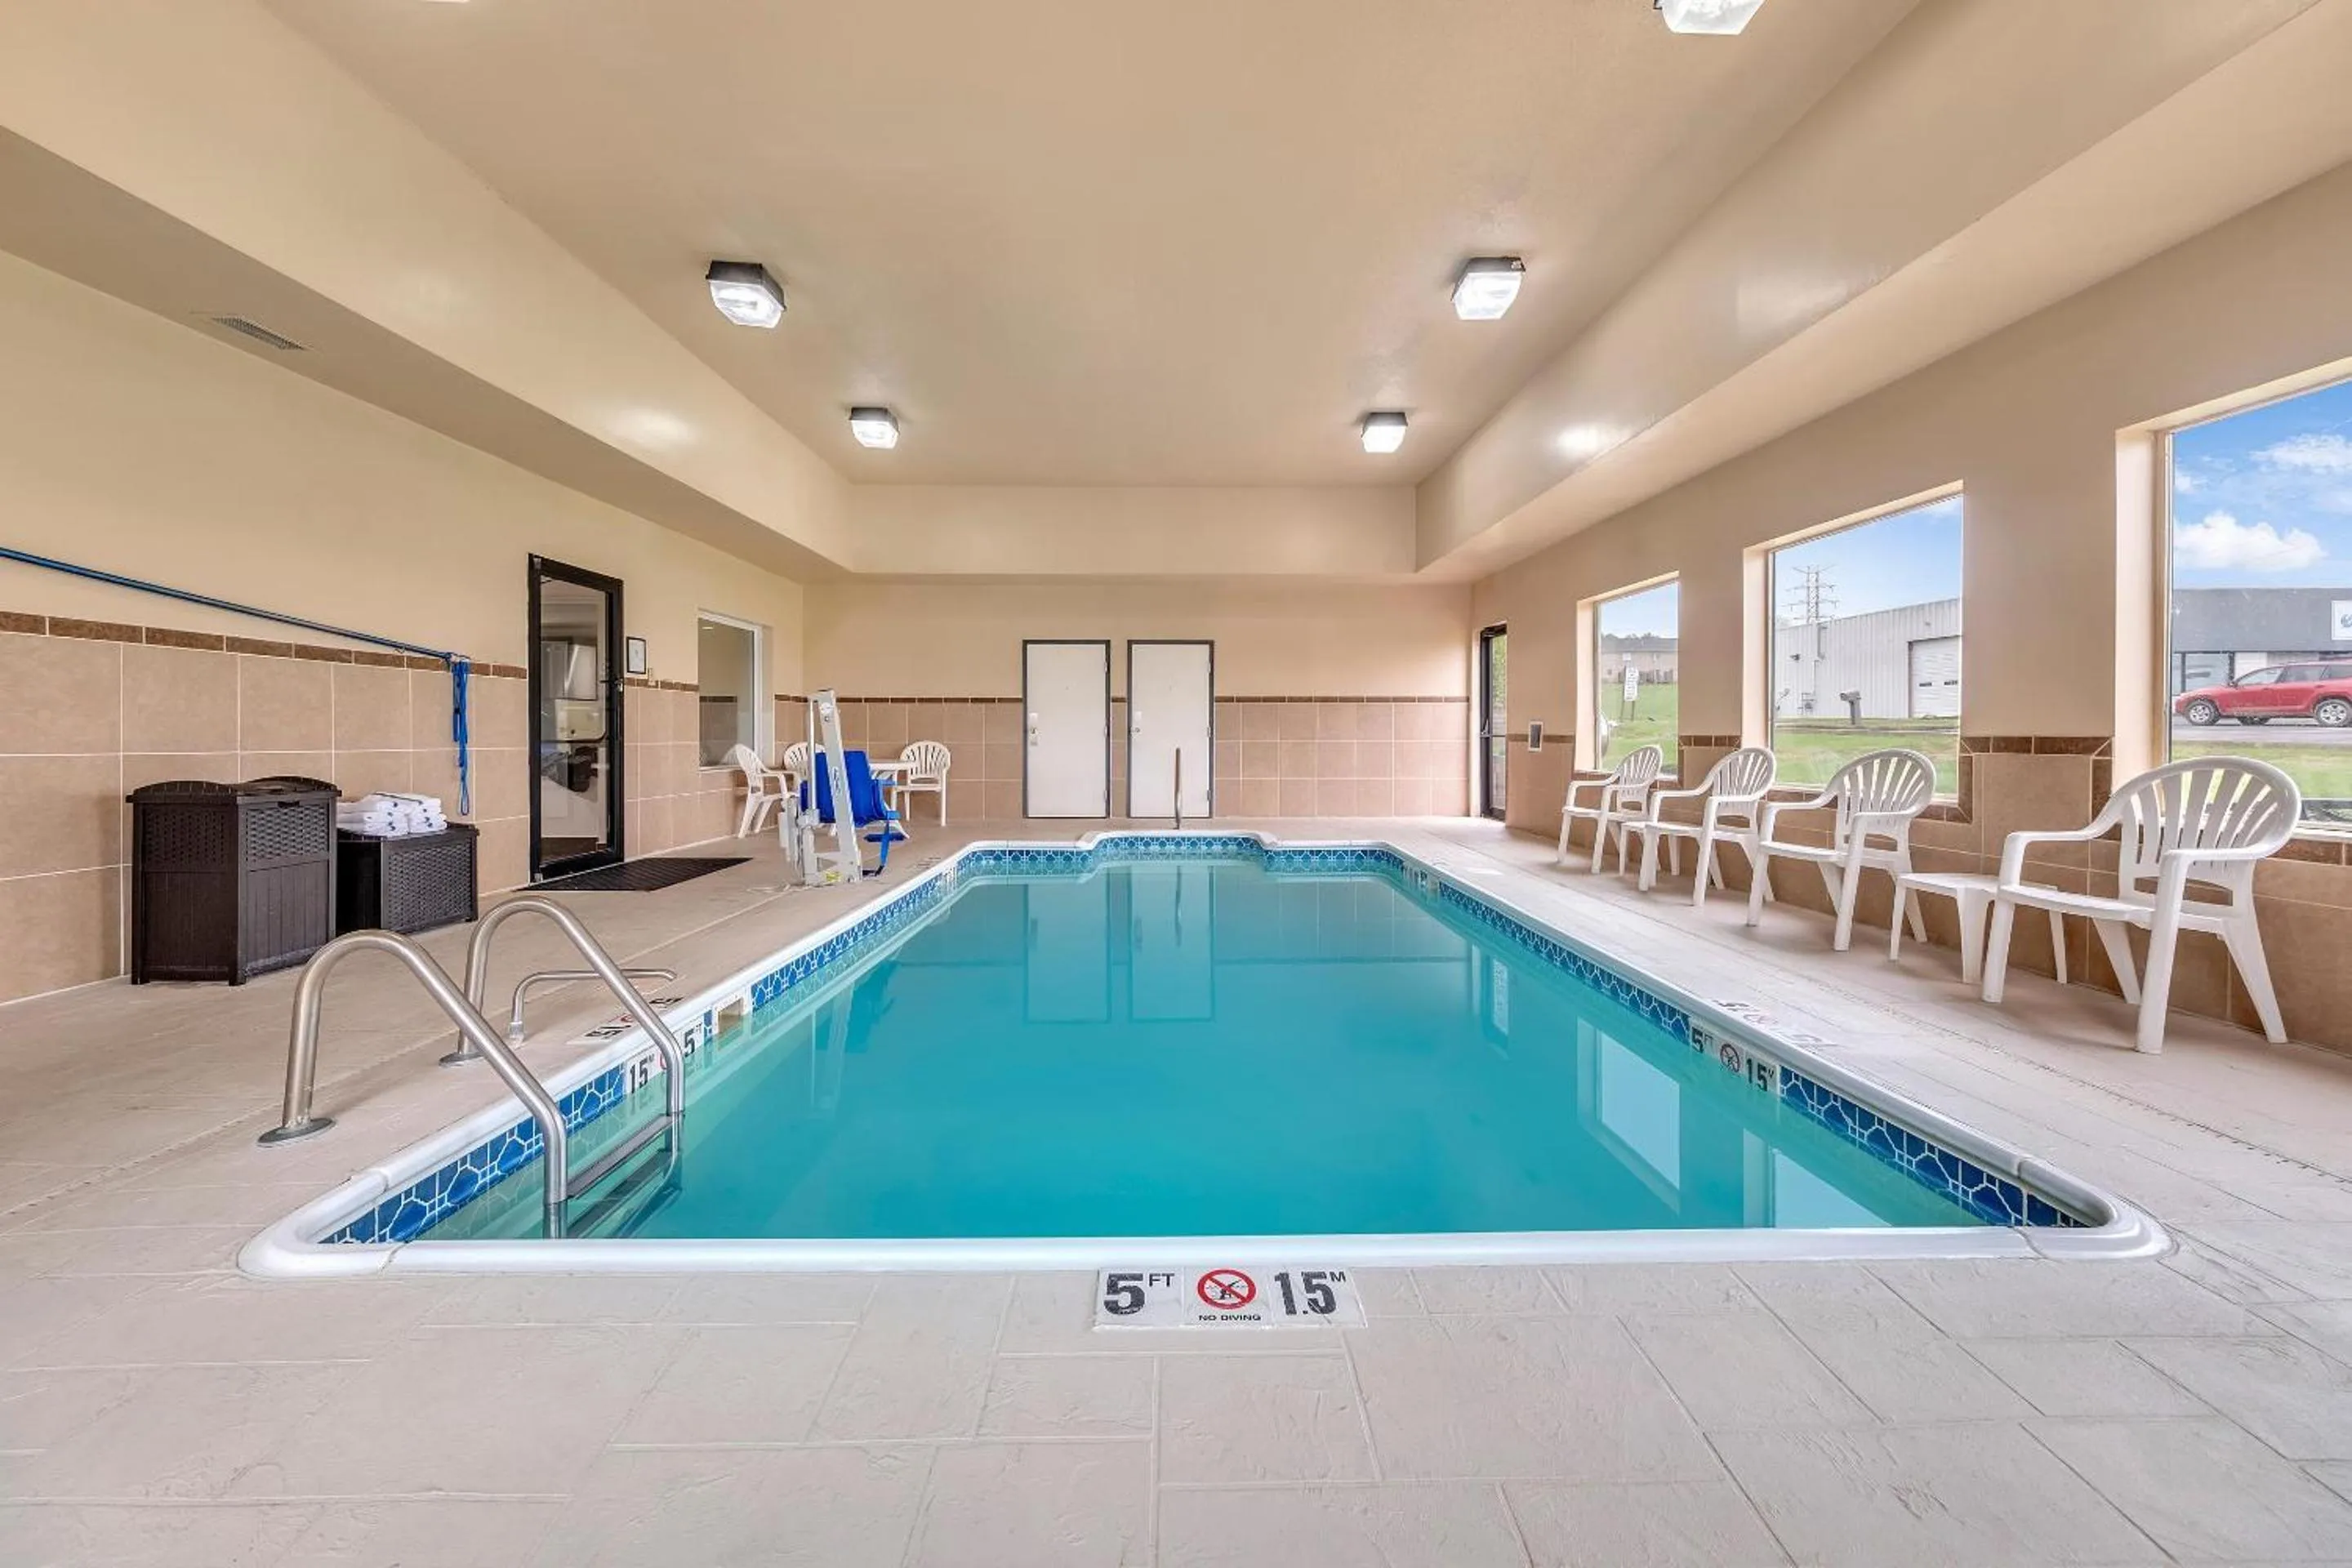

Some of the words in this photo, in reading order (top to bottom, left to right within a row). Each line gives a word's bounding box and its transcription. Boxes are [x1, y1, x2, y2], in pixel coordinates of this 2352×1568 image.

[684, 1027, 696, 1058] 5
[1691, 1026, 1704, 1054] 5
[1103, 1272, 1145, 1316] 5
[1148, 1272, 1175, 1288] FT
[1274, 1271, 1338, 1316] 1.5
[1330, 1271, 1346, 1283] M
[1220, 1313, 1262, 1321] DIVING
